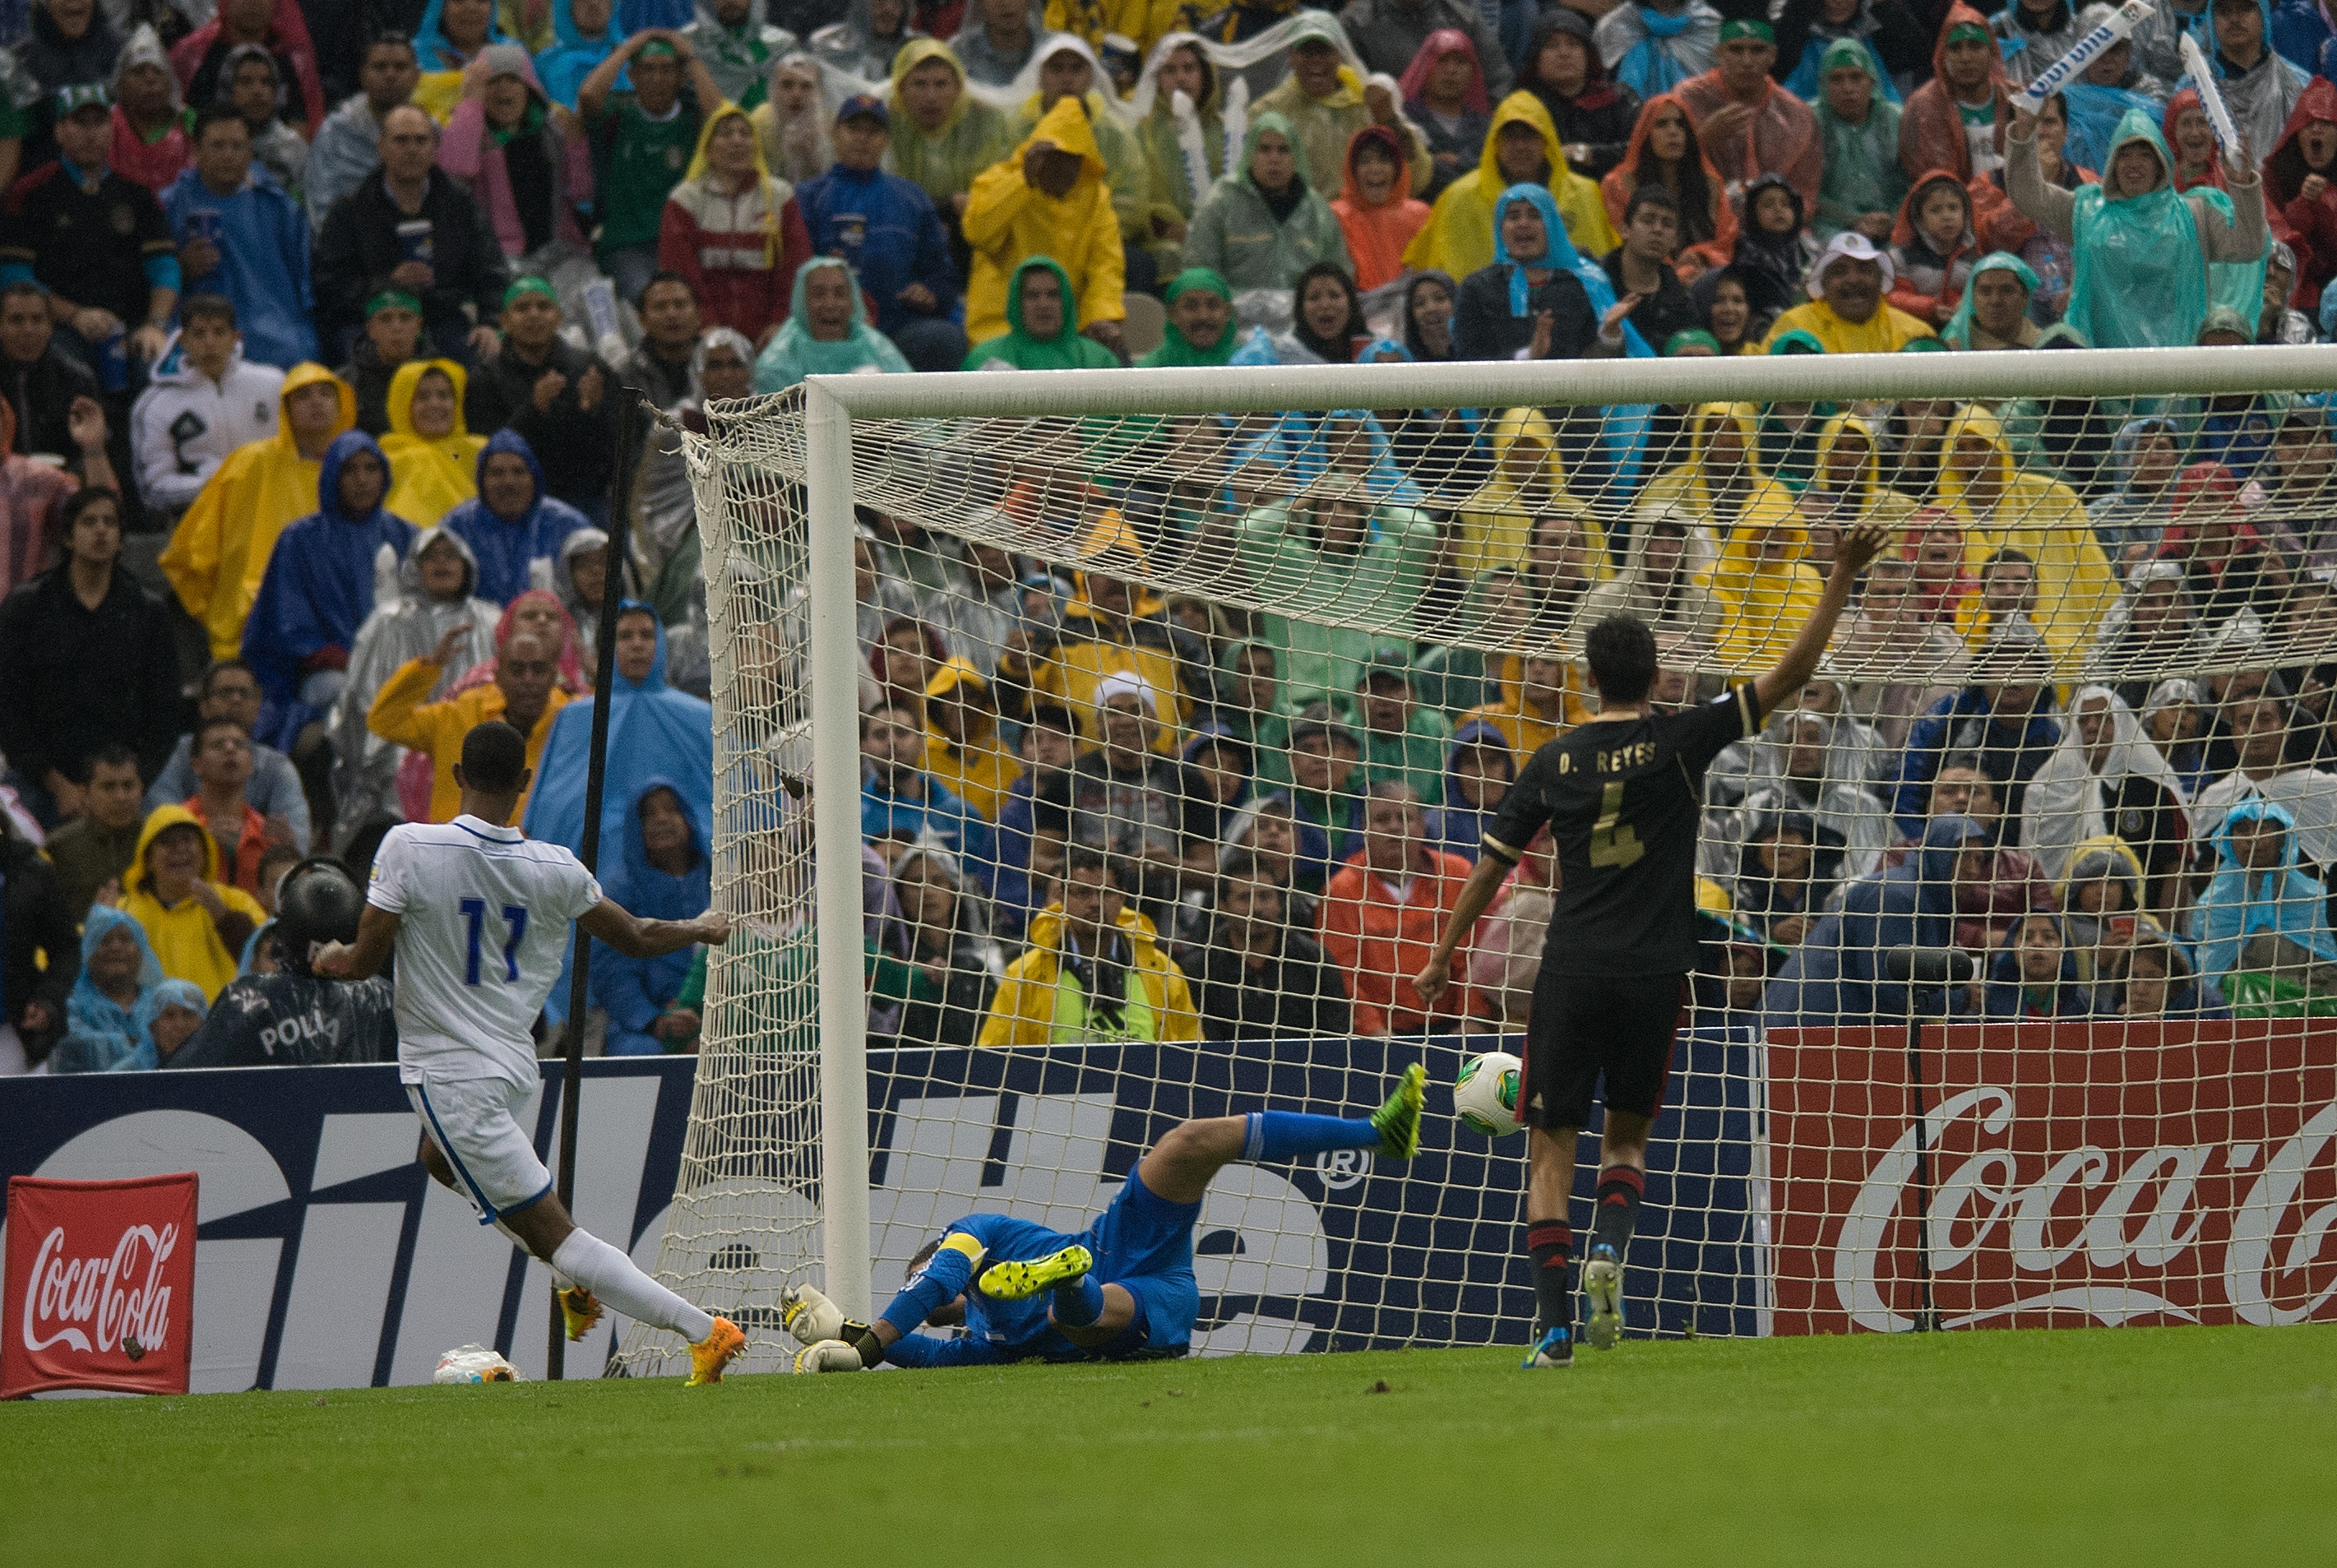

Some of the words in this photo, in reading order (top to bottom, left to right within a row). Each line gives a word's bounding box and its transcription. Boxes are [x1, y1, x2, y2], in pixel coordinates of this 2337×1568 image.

[1596, 741, 1656, 773] REYES
[1589, 781, 1645, 869] 4
[23, 1222, 179, 1353] Coca-Cola
